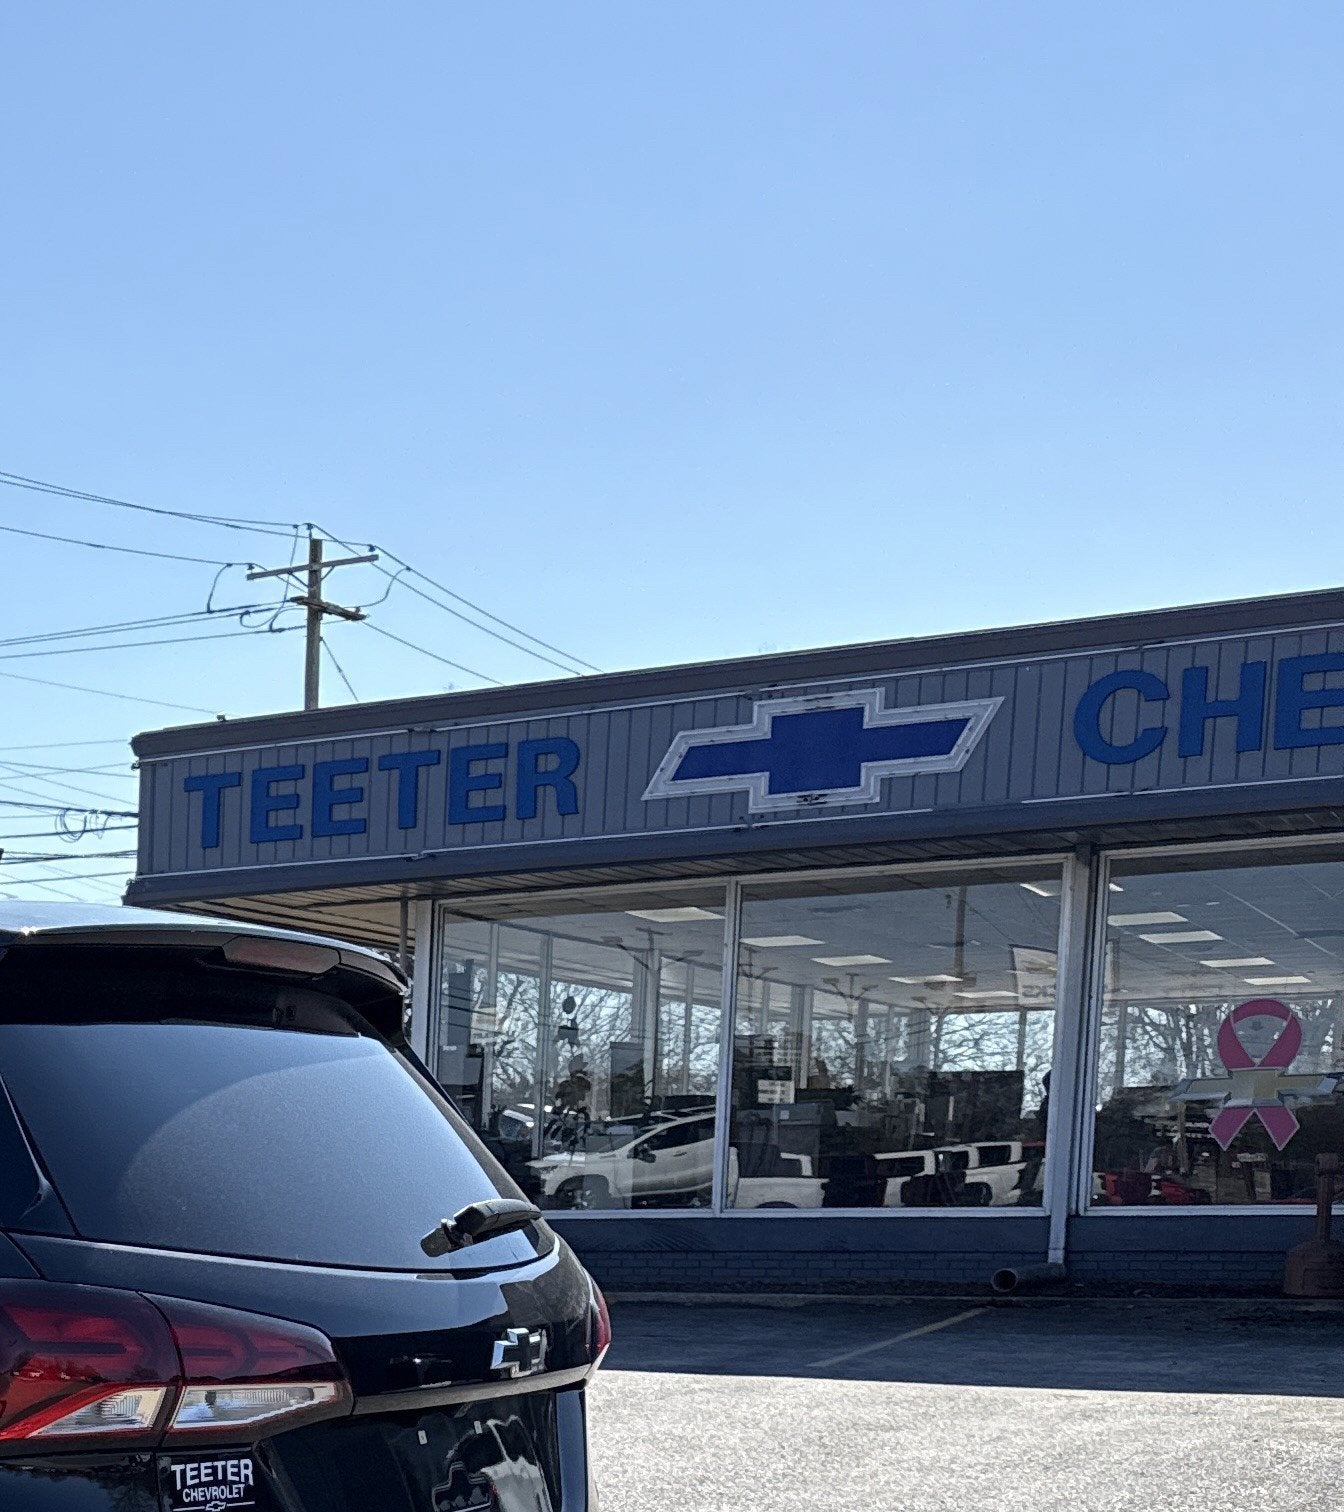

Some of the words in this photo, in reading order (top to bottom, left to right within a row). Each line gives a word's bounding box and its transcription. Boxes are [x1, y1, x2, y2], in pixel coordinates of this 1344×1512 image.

[183, 736, 581, 849] TEETER
[171, 1458, 254, 1490] TEETER
[182, 1484, 245, 1503] CHEVROLET
